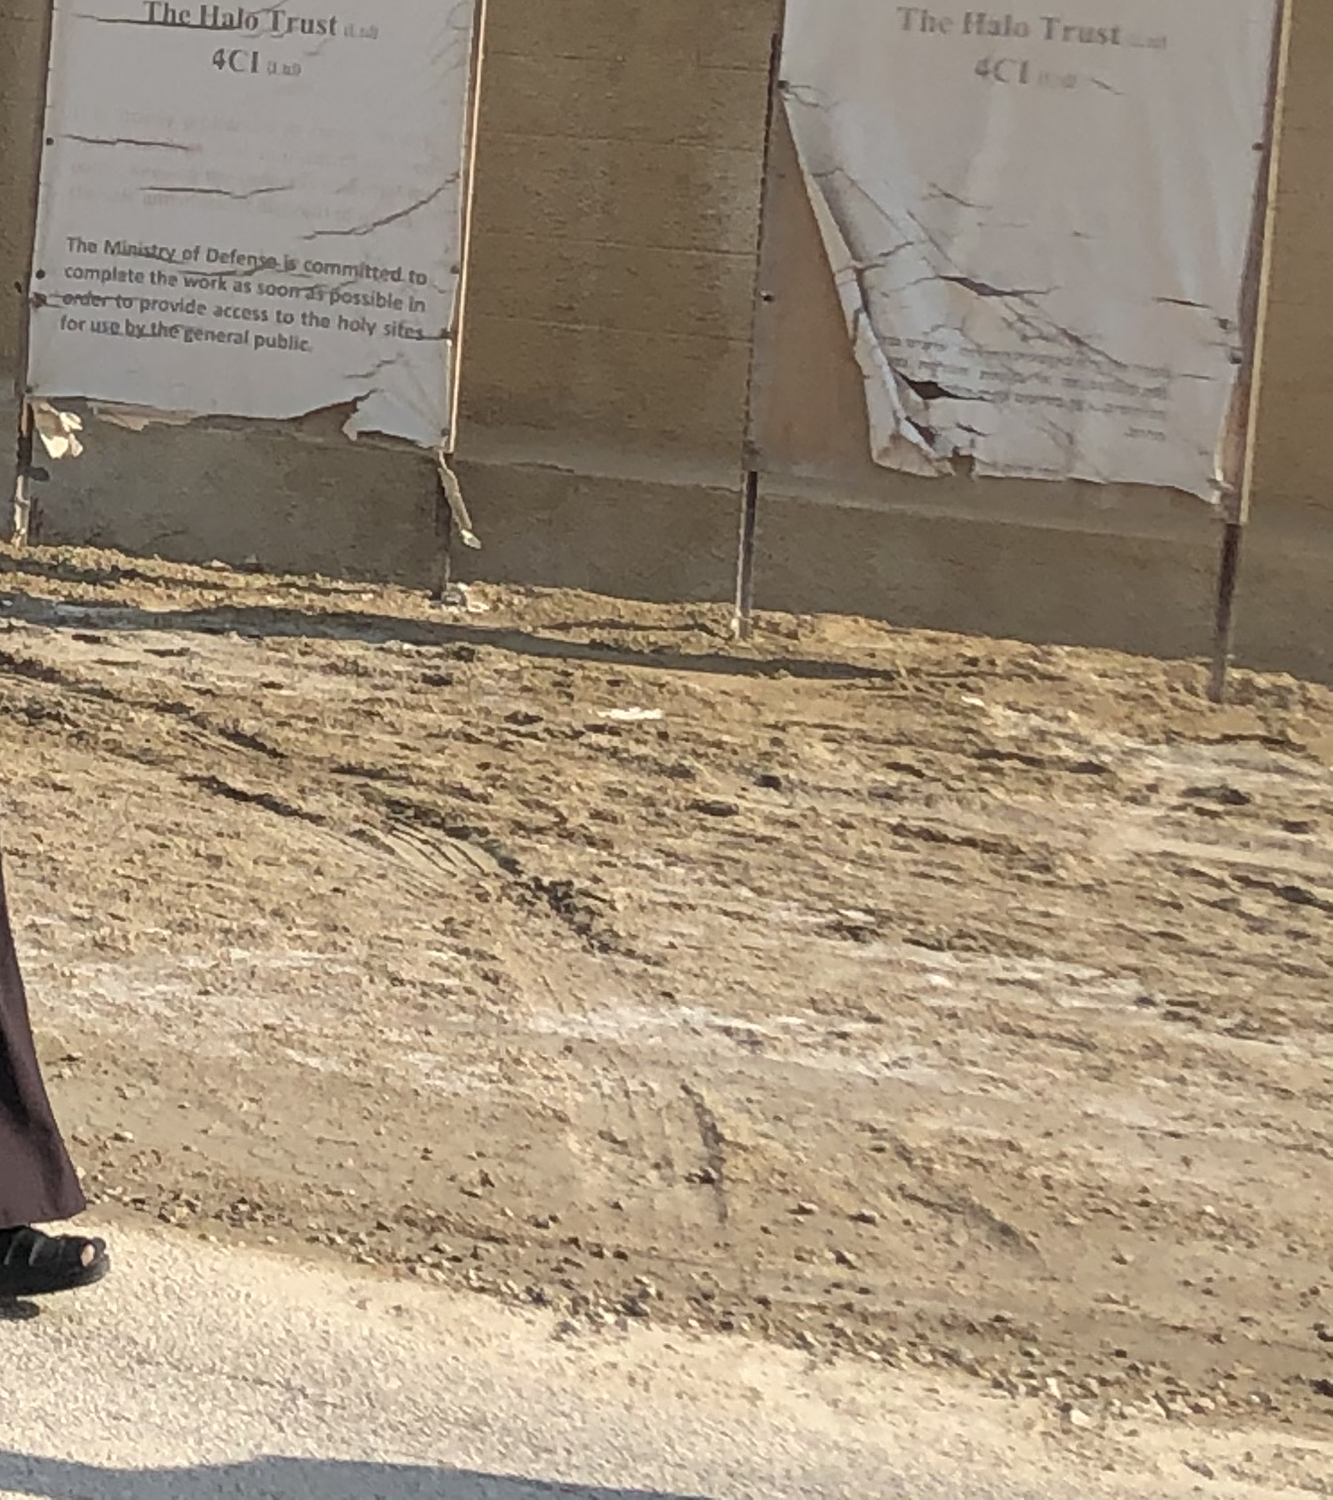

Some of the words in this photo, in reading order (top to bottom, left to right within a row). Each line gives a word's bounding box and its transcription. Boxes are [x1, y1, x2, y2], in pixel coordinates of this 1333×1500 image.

[143, 0, 191, 25] The
[200, 5, 258, 30] Halo
[269, 9, 337, 36] Trust
[897, 6, 953, 34] The
[963, 12, 1029, 37] Halo
[1040, 17, 1121, 45] Trust
[67, 237, 97, 254] The
[103, 240, 176, 262] Ministry
[182, 248, 200, 261] of
[206, 248, 278, 269] Defense
[284, 255, 296, 272] is
[304, 259, 402, 282] committed
[409, 270, 427, 286] to
[64, 265, 144, 286] complete
[150, 270, 178, 288] the
[184, 274, 227, 292] work
[233, 279, 251, 293] as
[256, 282, 299, 299] soon
[305, 286, 324, 301] as
[330, 288, 403, 312] possible
[409, 298, 425, 313] in
[60, 315, 85, 333] for
[90, 320, 120, 335] use
[125, 318, 145, 339] by
[151, 321, 179, 339] the
[185, 327, 248, 346] general
[62, 293, 107, 308] order
[115, 294, 133, 309] to
[140, 298, 206, 318] provide
[213, 305, 268, 322] access
[276, 310, 294, 325] to
[301, 312, 330, 329] the
[338, 315, 376, 337] holy
[384, 321, 423, 341] sites
